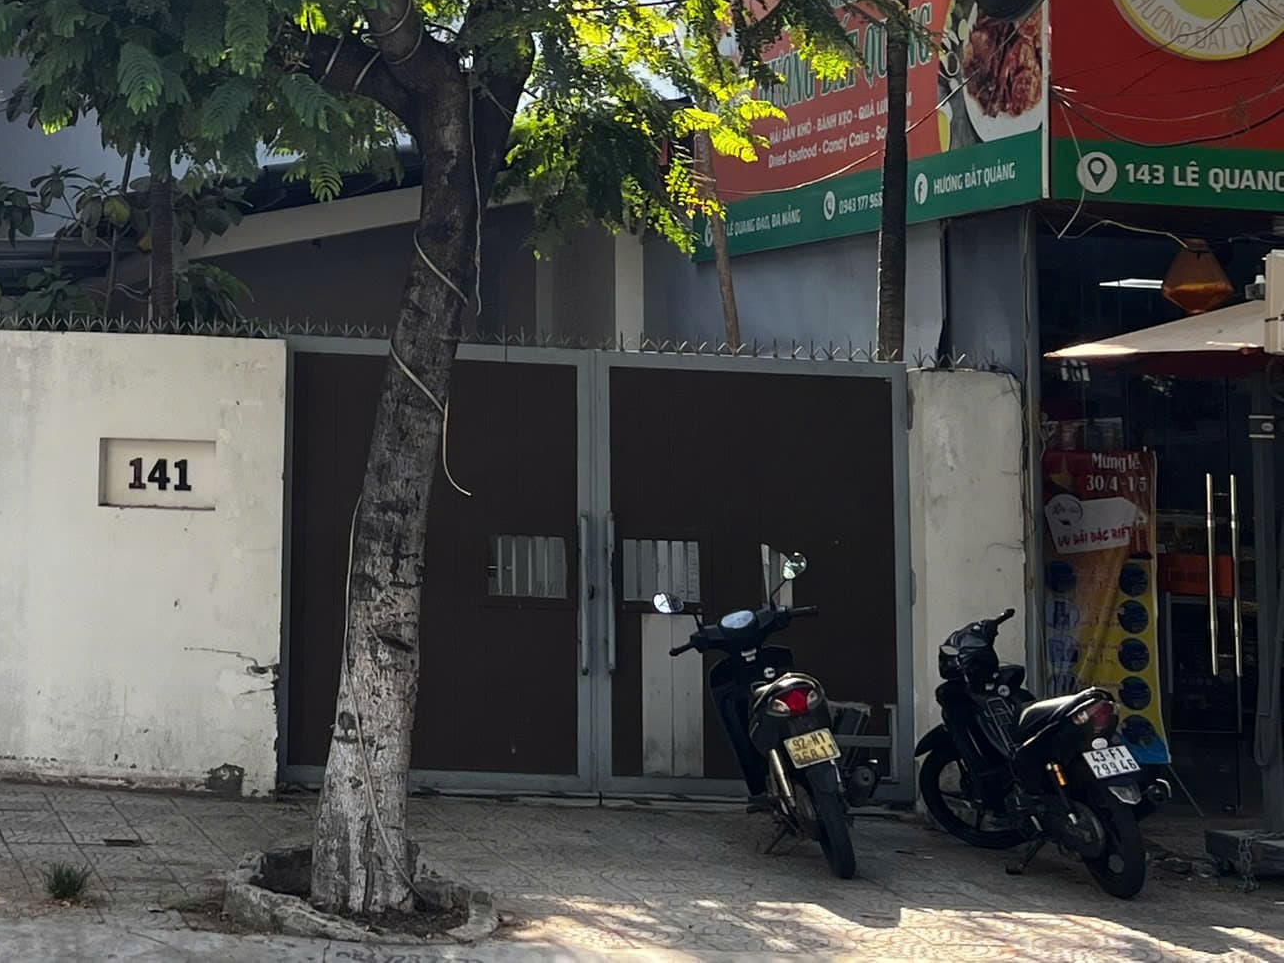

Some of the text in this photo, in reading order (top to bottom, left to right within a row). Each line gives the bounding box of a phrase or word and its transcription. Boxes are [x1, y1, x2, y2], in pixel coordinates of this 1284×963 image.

[768, 150, 787, 168] Dried
[788, 142, 817, 163] Seafood
[822, 135, 848, 155] Candy
[849, 130, 870, 147] Cake
[933, 173, 963, 195] HƯƠNG
[964, 164, 983, 189] ĐẤT
[983, 159, 1016, 188] QUẢNG
[1125, 163, 1165, 186] 143
[1173, 160, 1200, 187] LÊ
[128, 457, 192, 492] 141
